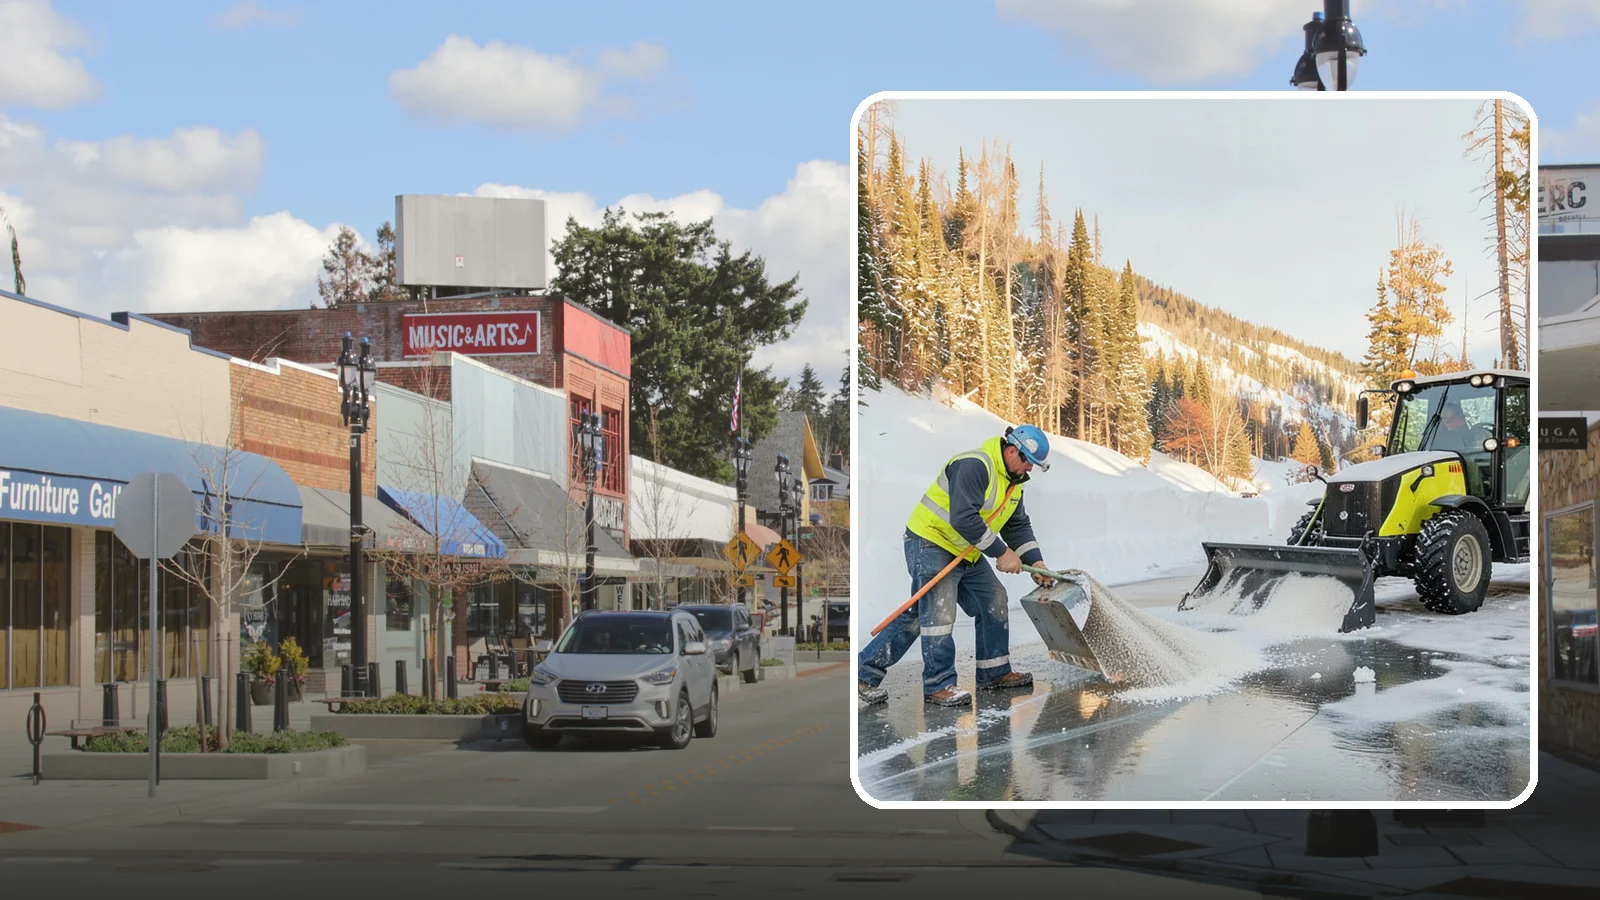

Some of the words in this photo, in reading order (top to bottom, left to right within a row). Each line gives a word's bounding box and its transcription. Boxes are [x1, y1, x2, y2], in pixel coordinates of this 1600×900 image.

[408, 323, 520, 348] MUSIC&ARTS
[0, 471, 79, 515] Furniture
[89, 482, 122, 519] Gal
[453, 563, 480, 574] SUSHI
